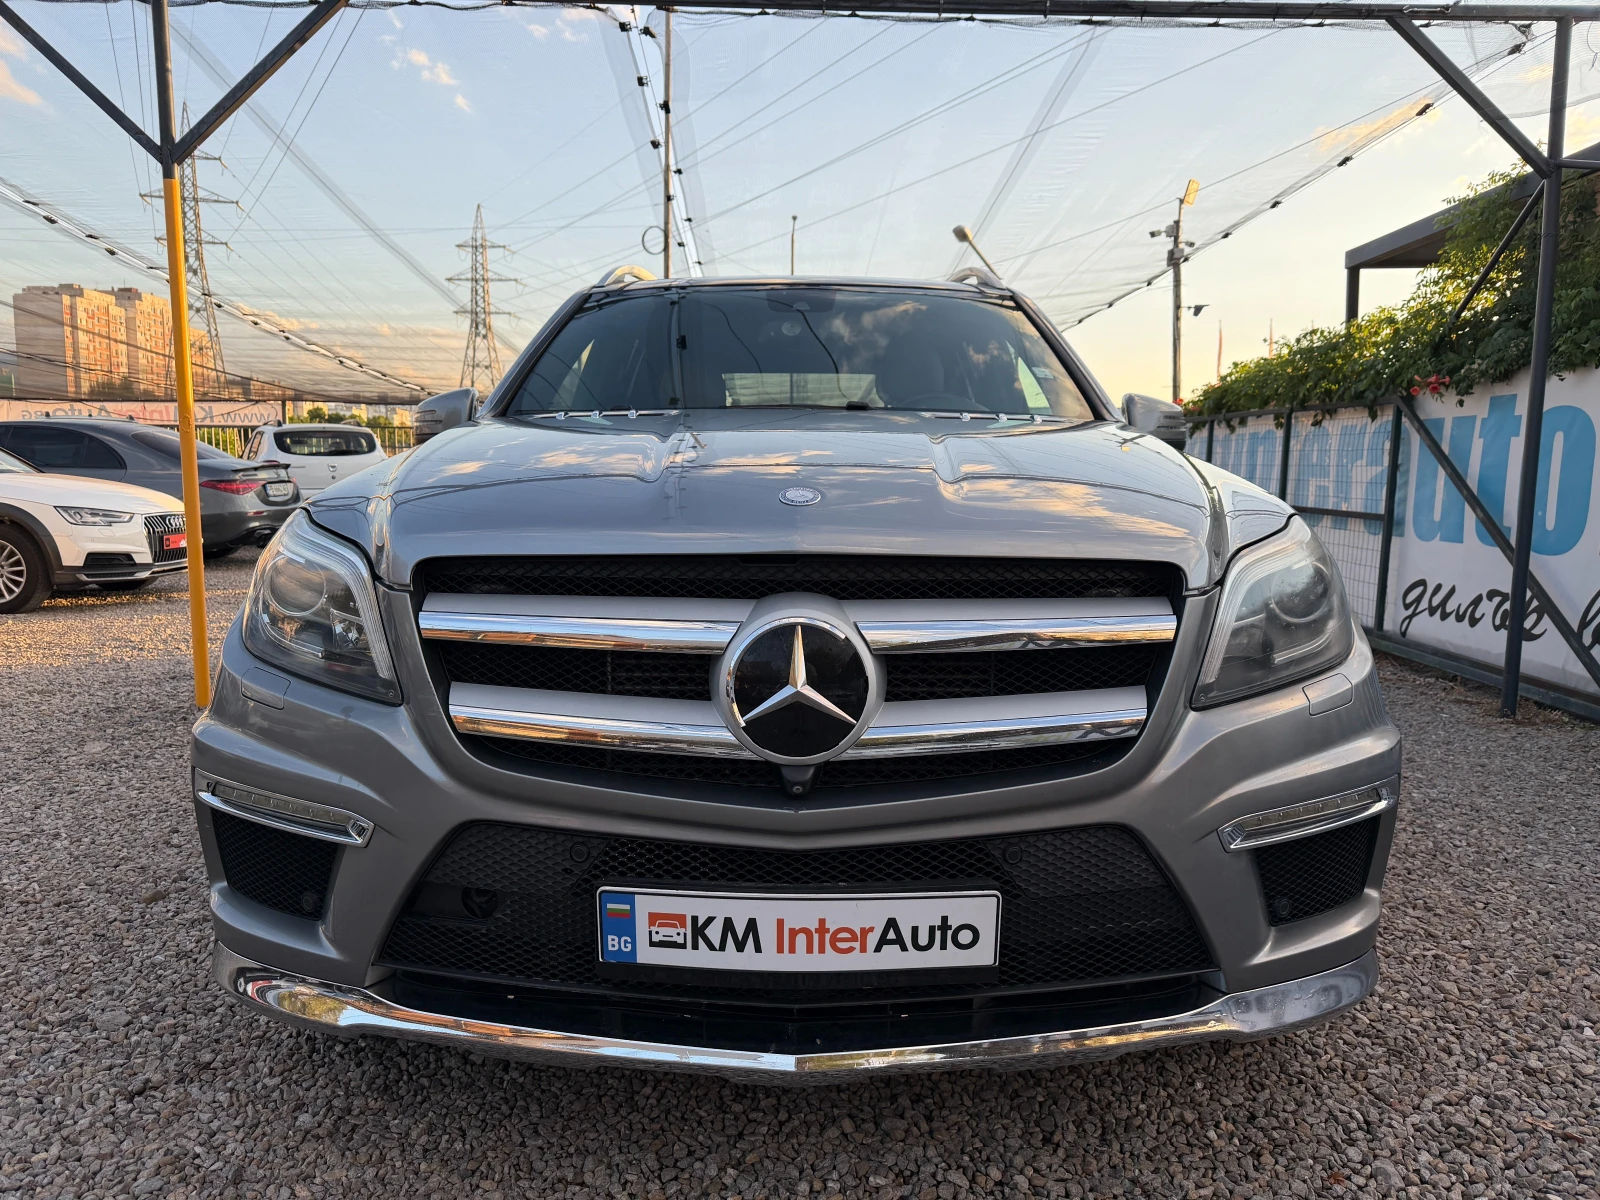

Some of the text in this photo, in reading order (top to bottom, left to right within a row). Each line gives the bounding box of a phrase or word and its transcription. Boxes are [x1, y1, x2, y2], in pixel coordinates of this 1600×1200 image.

[607, 935, 632, 952] BG
[691, 915, 981, 955] KM InterAuto
